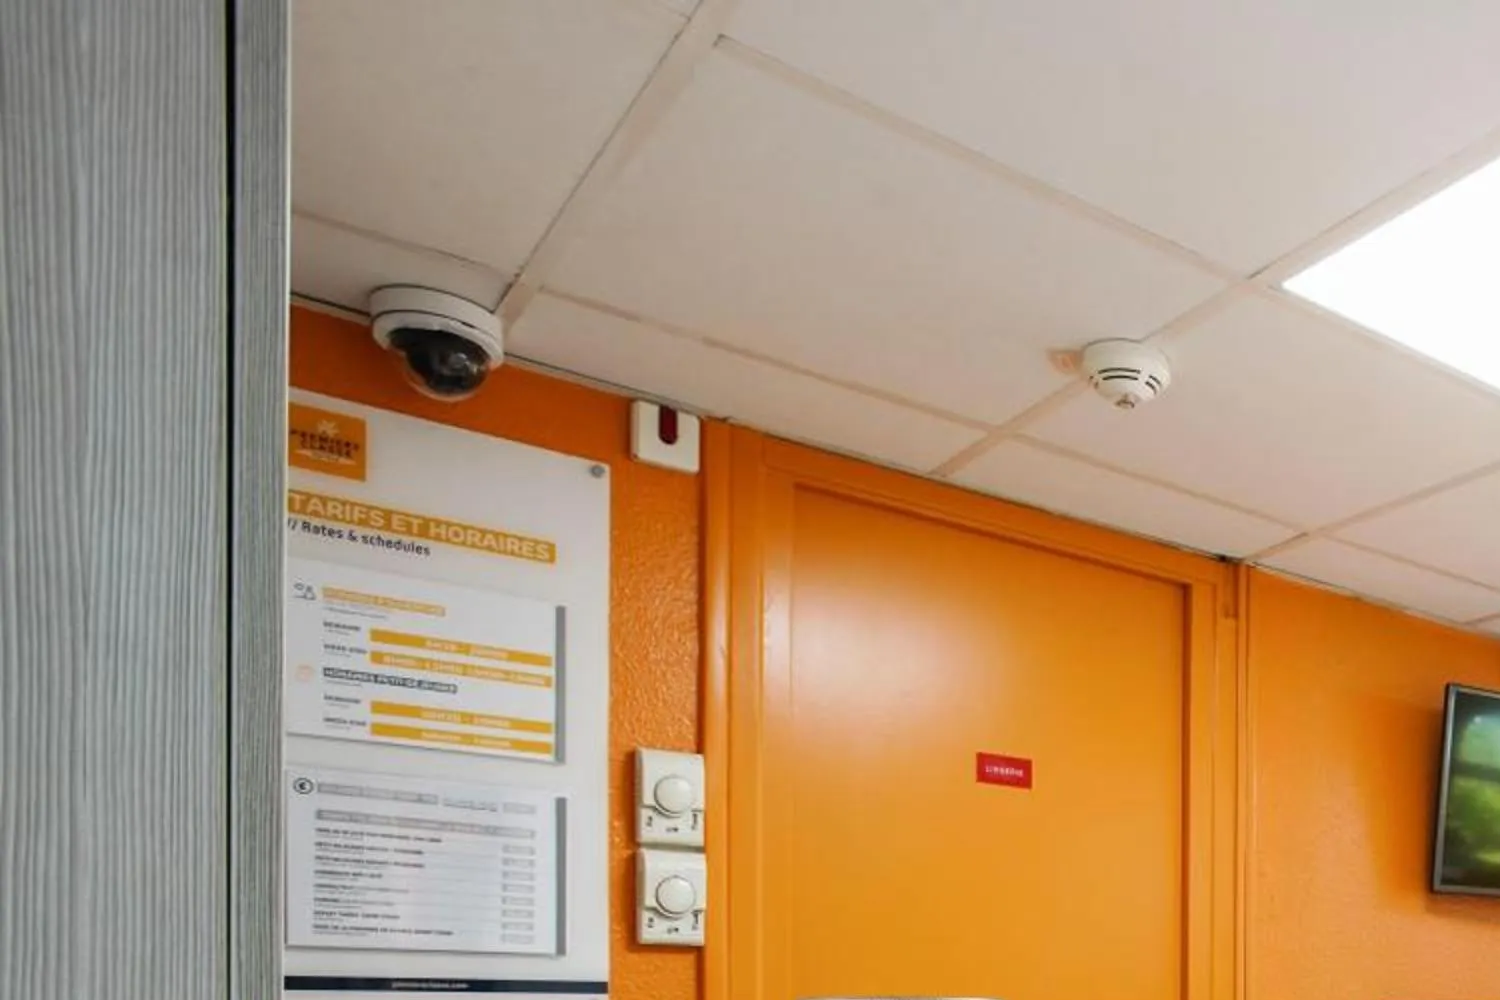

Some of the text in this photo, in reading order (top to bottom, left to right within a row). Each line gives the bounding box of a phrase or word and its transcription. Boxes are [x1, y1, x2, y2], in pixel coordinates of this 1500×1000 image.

[291, 493, 550, 562] TARIFS ET HORAIRES
[301, 520, 344, 540] Rates
[346, 529, 359, 543] &
[360, 533, 431, 557] schedules
